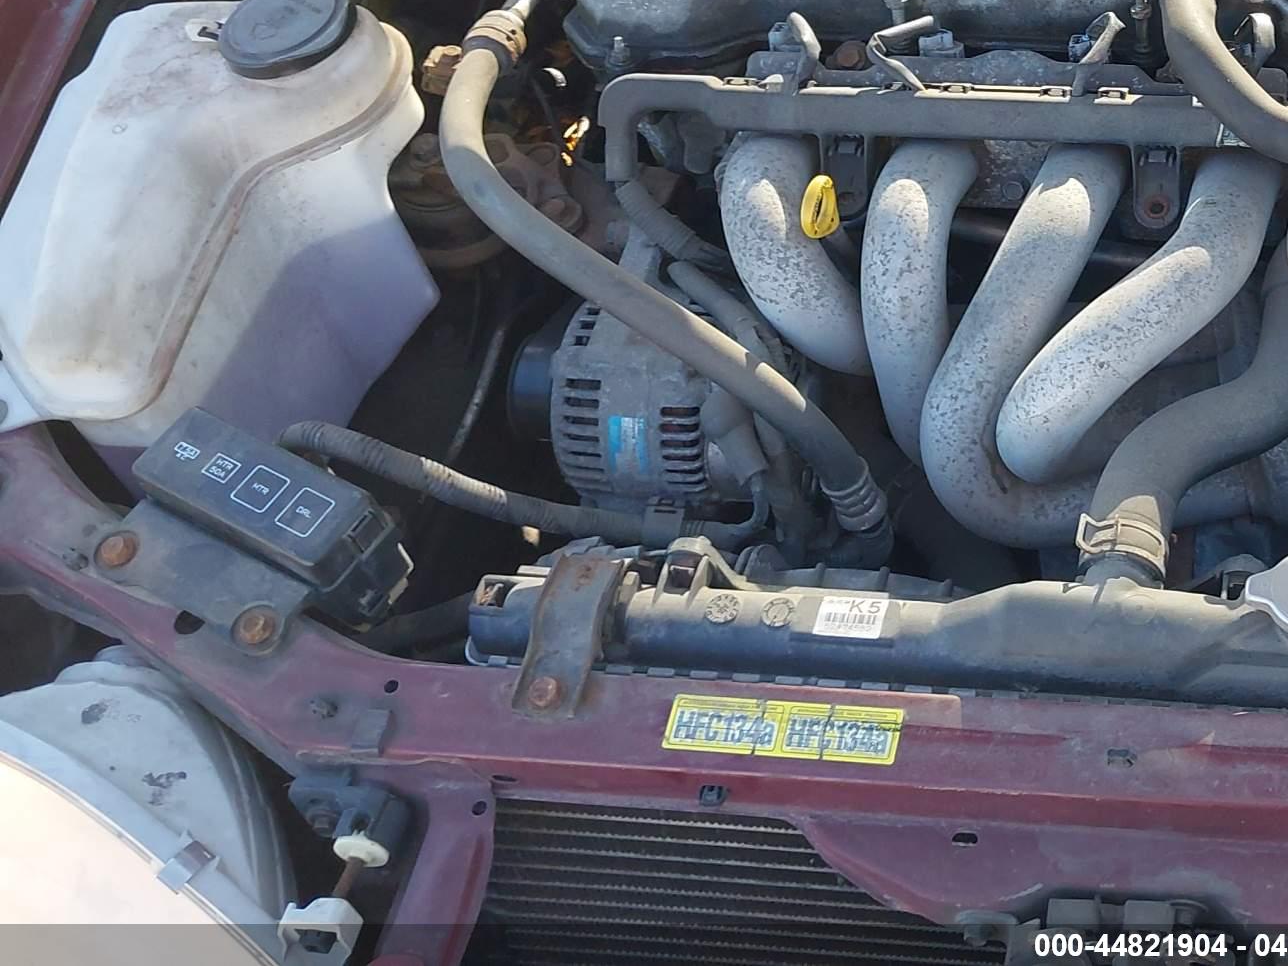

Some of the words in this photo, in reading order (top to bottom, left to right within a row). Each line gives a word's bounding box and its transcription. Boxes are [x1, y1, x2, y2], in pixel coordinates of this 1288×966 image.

[214, 457, 236, 471] HTR
[251, 481, 271, 496] HTR
[295, 505, 312, 519] DRL
